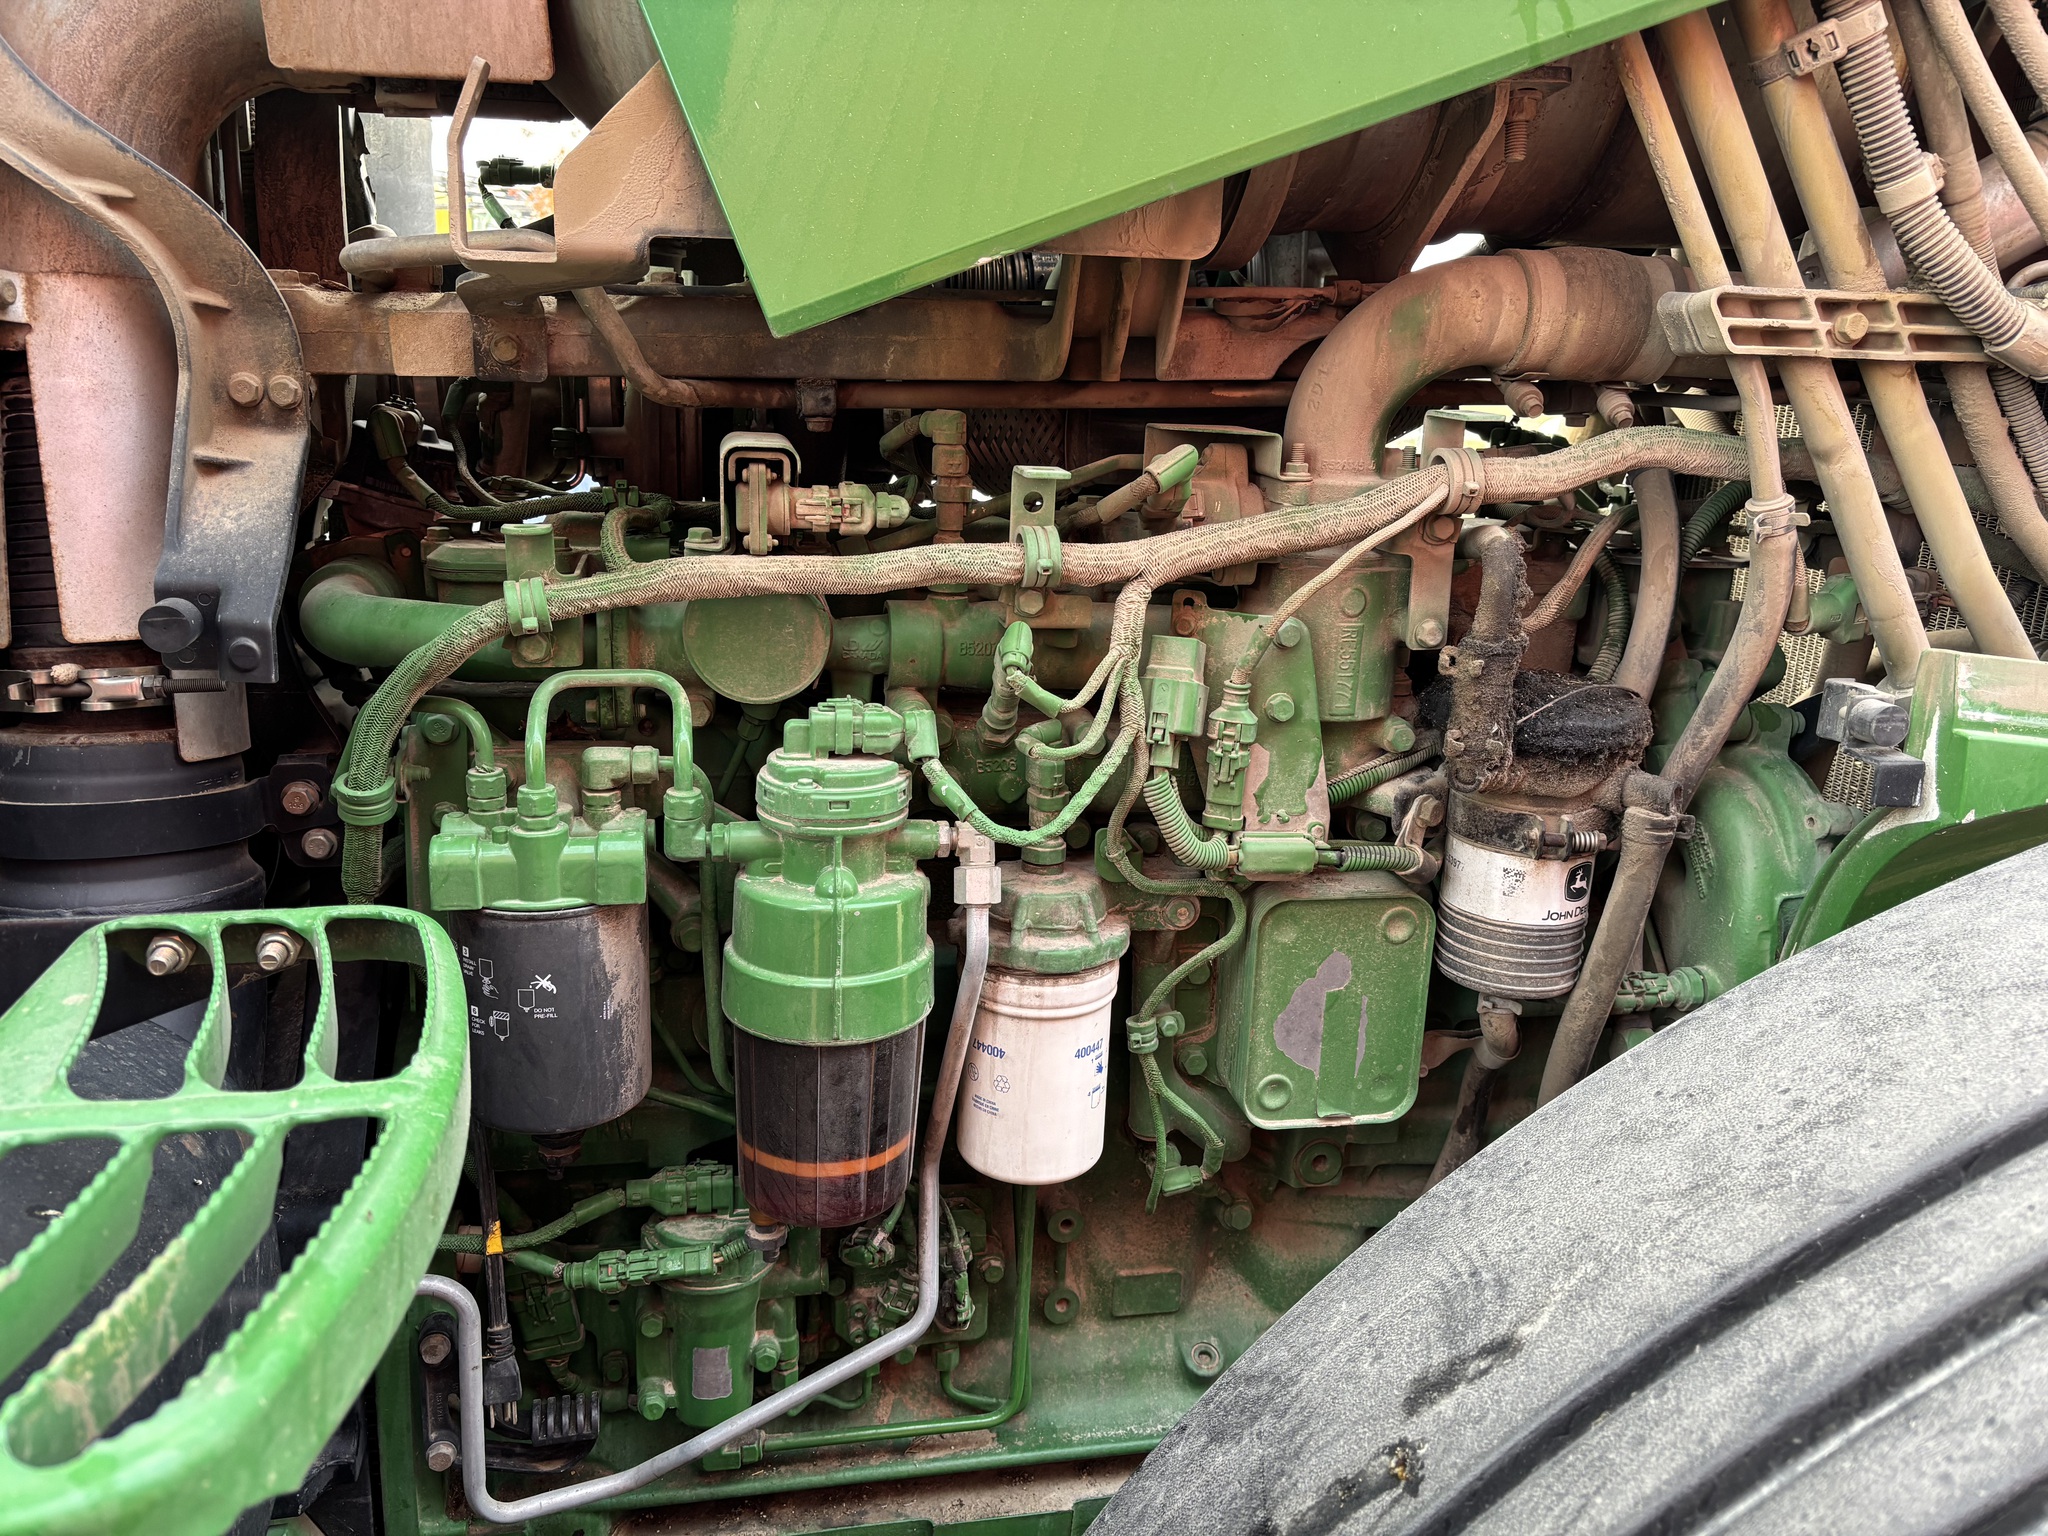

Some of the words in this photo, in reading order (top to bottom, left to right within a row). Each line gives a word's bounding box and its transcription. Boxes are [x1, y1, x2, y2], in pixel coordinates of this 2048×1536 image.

[1541, 909, 1574, 921] JOHN
[471, 1016, 486, 1025] CHECK
[472, 1028, 485, 1036] LEAKS
[972, 1038, 1006, 1060] 400447
[1075, 1038, 1103, 1059] 400447
